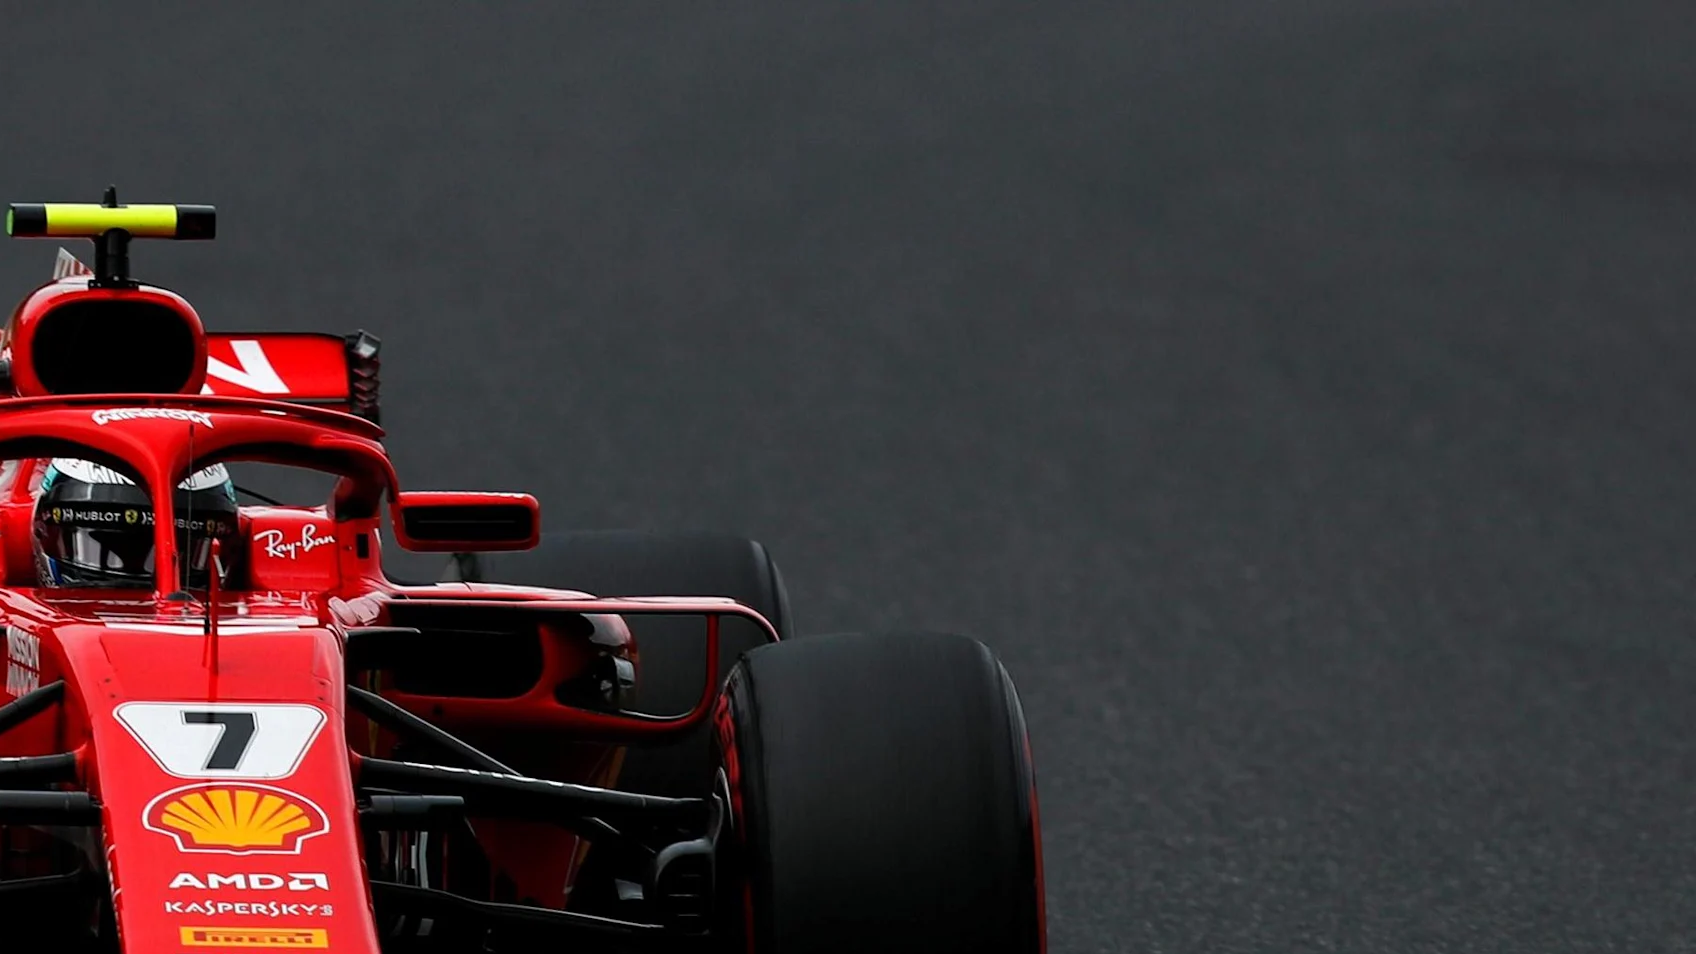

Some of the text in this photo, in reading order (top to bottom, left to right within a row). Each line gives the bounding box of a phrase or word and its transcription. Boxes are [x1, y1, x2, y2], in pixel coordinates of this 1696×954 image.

[75, 511, 121, 522] HUBLOT
[254, 524, 336, 559] Ray-Ban
[181, 710, 257, 771] 7
[169, 873, 284, 890] AMD
[165, 900, 318, 917] KASPERSKY
[193, 931, 314, 944] PIRELLI
